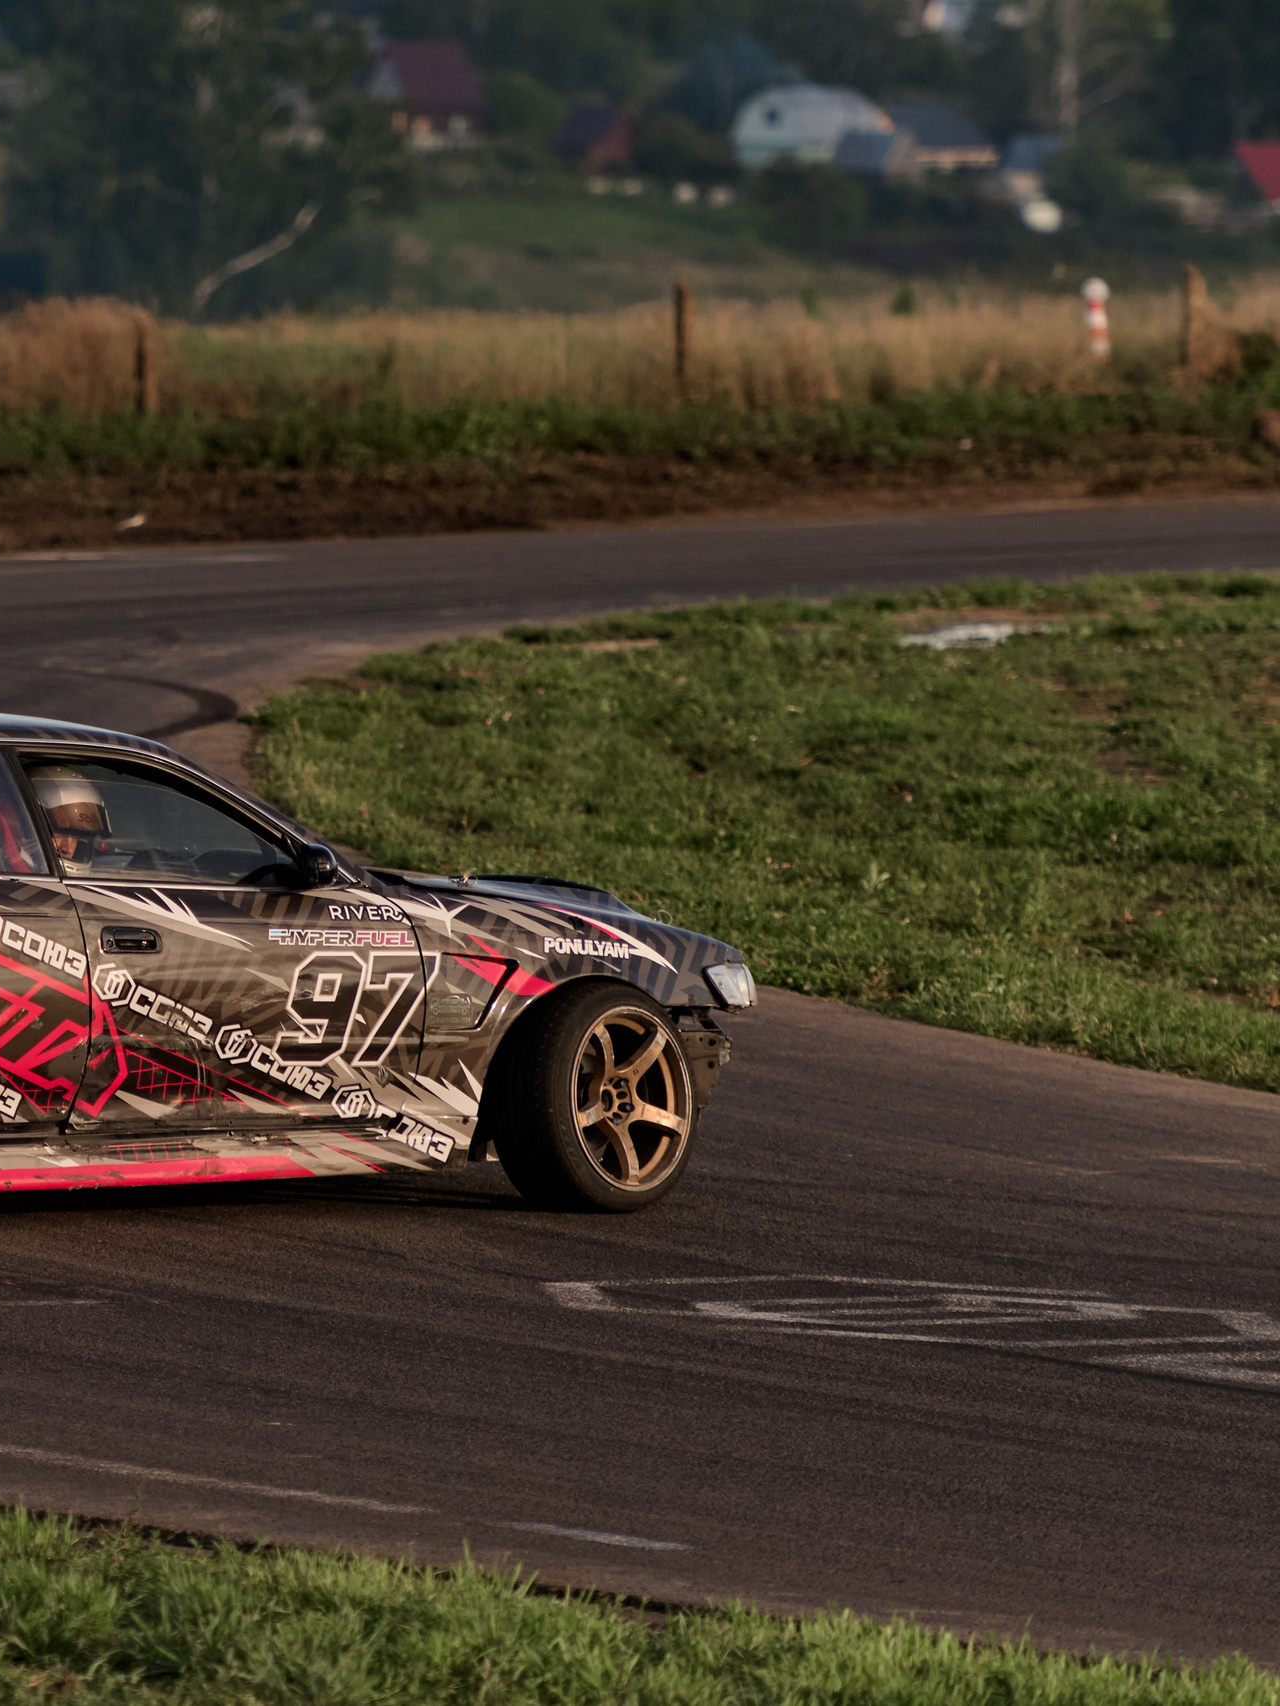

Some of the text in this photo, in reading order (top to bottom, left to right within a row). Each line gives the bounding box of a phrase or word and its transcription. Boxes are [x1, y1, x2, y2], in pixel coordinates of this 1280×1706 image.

[2, 922, 88, 979] СОЮЗ
[544, 936, 630, 960] PONULYAM
[271, 951, 441, 1067] 97
